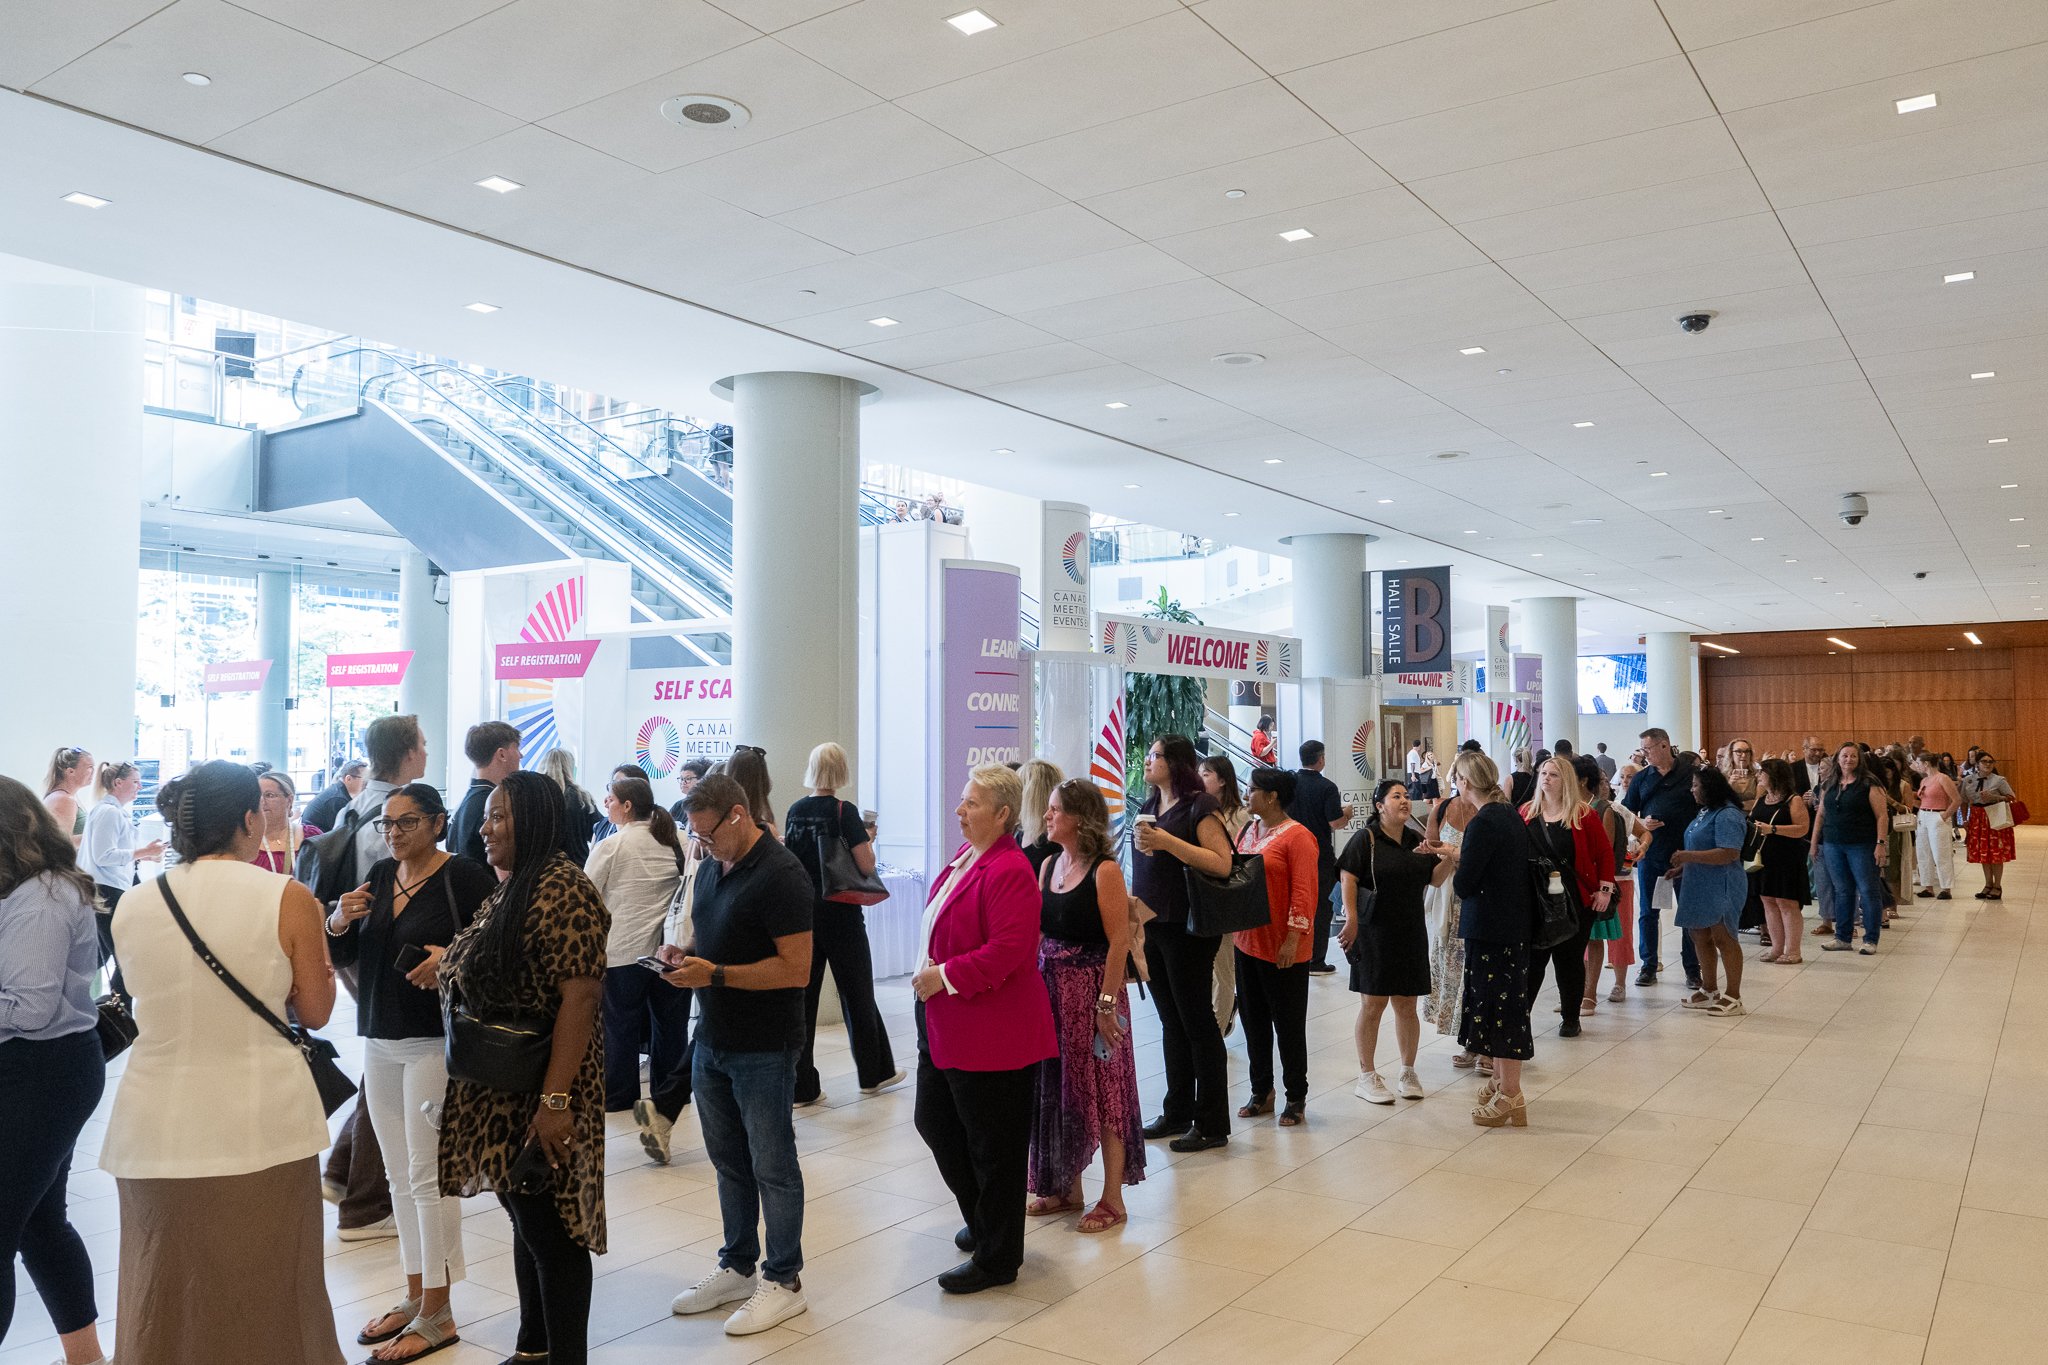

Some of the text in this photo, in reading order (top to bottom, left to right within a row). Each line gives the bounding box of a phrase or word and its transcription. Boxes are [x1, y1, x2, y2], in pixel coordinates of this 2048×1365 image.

[1388, 579, 1400, 612] HALL
[1404, 576, 1445, 664] B
[500, 653, 582, 667] SELF REGISTRATION
[1168, 633, 1250, 670] WELCOME
[1388, 624, 1401, 664] SALLE
[330, 663, 399, 676] SELF REGISTRATION
[654, 680, 694, 700] SELF
